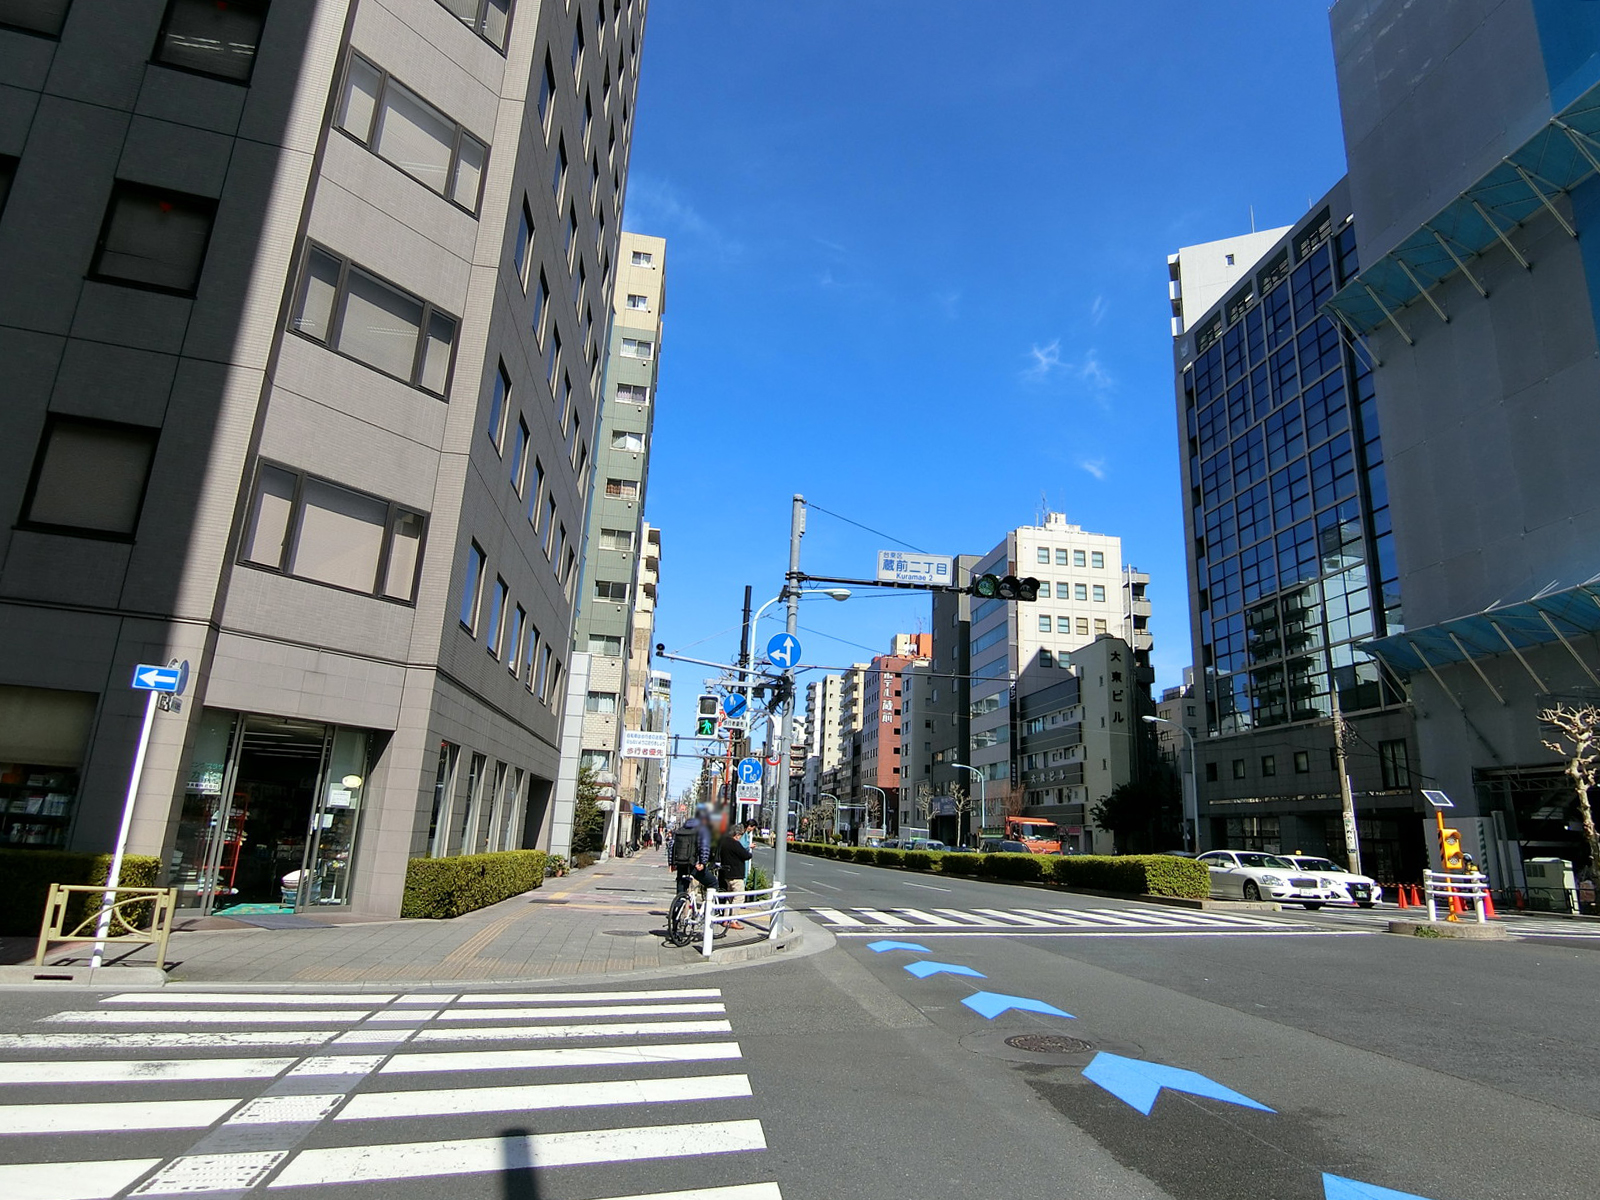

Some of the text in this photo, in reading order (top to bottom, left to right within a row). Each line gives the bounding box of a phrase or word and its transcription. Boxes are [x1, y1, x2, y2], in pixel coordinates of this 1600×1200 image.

[882, 559, 947, 575] 蔵前二丁目
[896, 572, 926, 581] Kuramae
[1110, 651, 1124, 723] 大東ビル
[882, 672, 893, 723] ホテル蔵前
[626, 747, 664, 757] 歩行者優先
[743, 764, 753, 781] P
[749, 773, 757, 782] 60
[1030, 770, 1066, 784] 大東ビル
